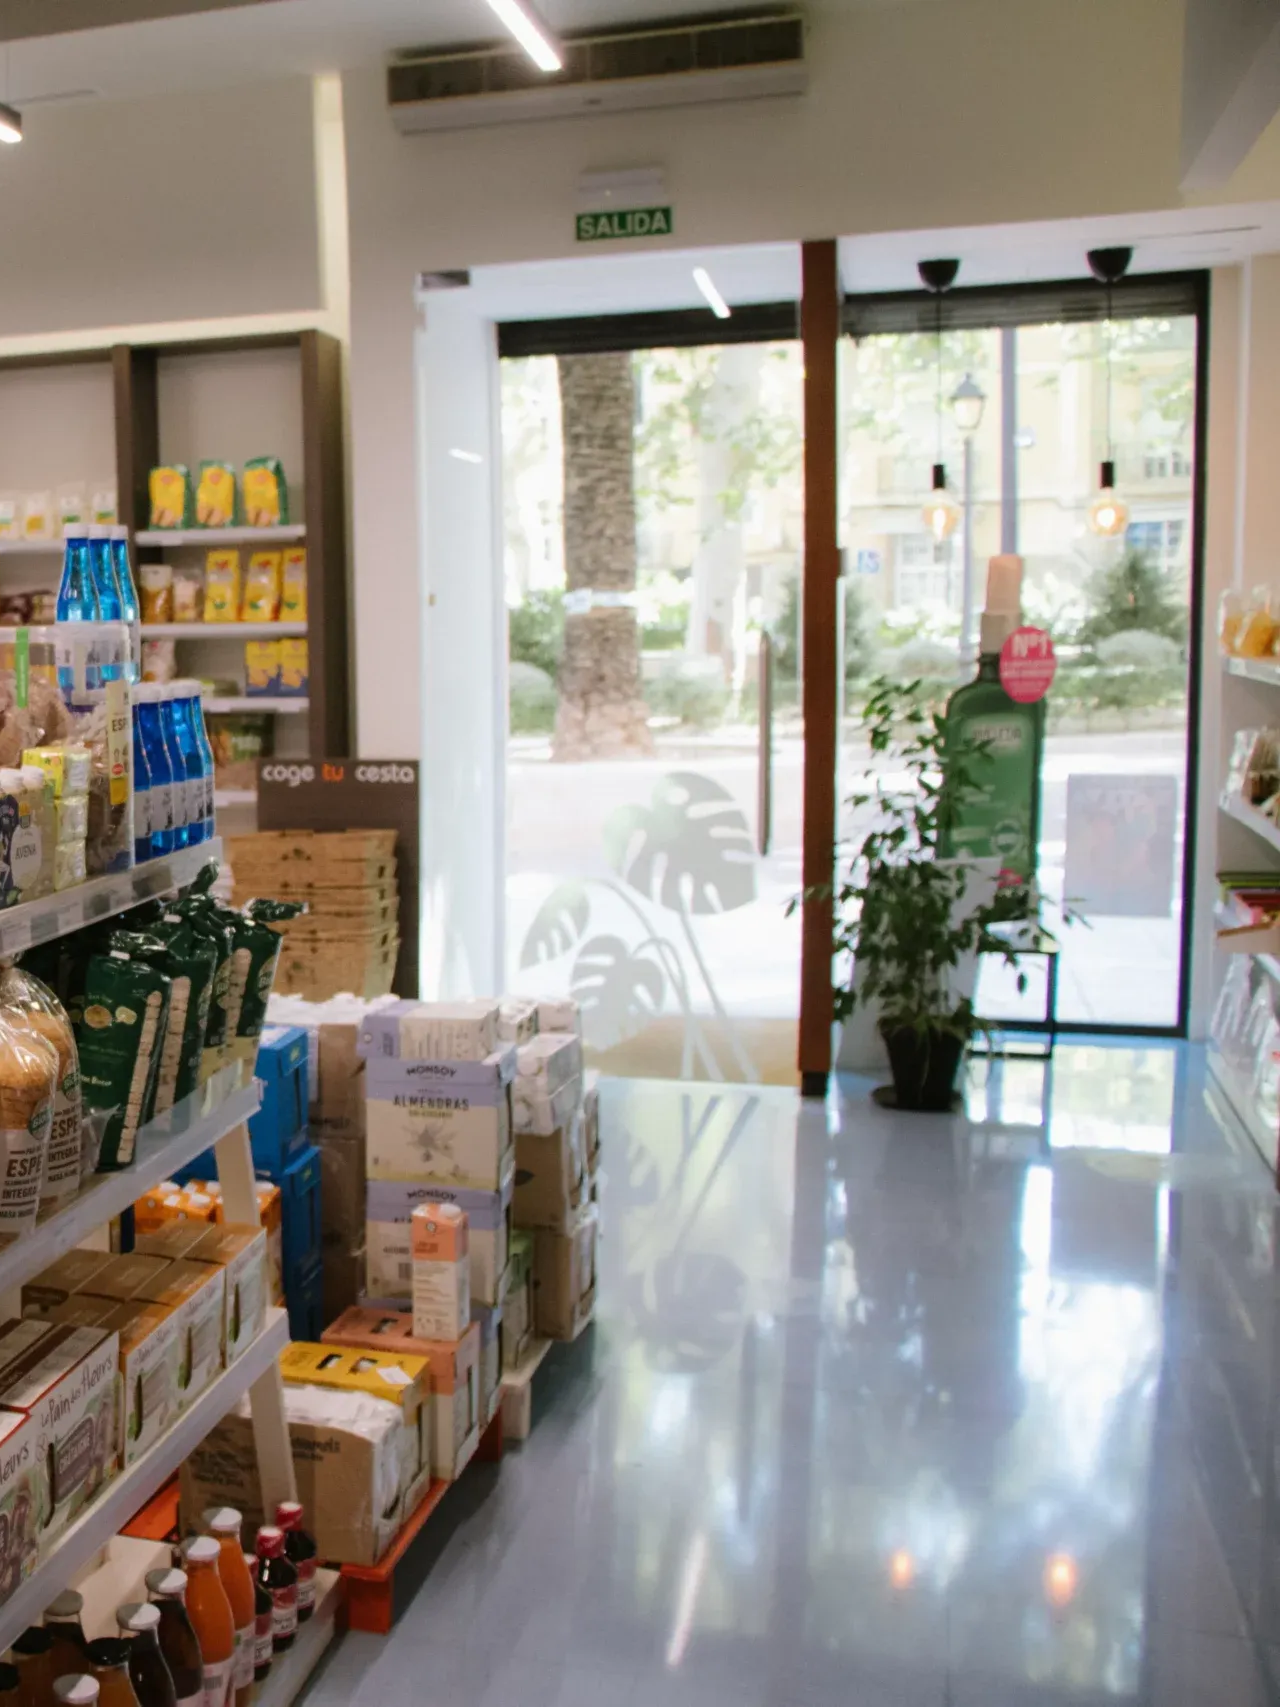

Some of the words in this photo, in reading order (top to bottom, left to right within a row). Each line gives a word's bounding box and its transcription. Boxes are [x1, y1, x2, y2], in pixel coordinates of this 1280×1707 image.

[580, 211, 668, 238] SALIDA
[261, 763, 316, 788] coge
[321, 762, 345, 783] tu
[354, 763, 416, 784] cesta
[392, 1096, 470, 1111] ALMENDRAS
[50, 1117, 78, 1141] ESPE
[6, 1153, 42, 1178] ESPE
[2, 1185, 38, 1200] INTEGRA
[48, 1394, 71, 1428] Pain
[70, 1388, 82, 1405] des
[80, 1353, 114, 1403] fleurs
